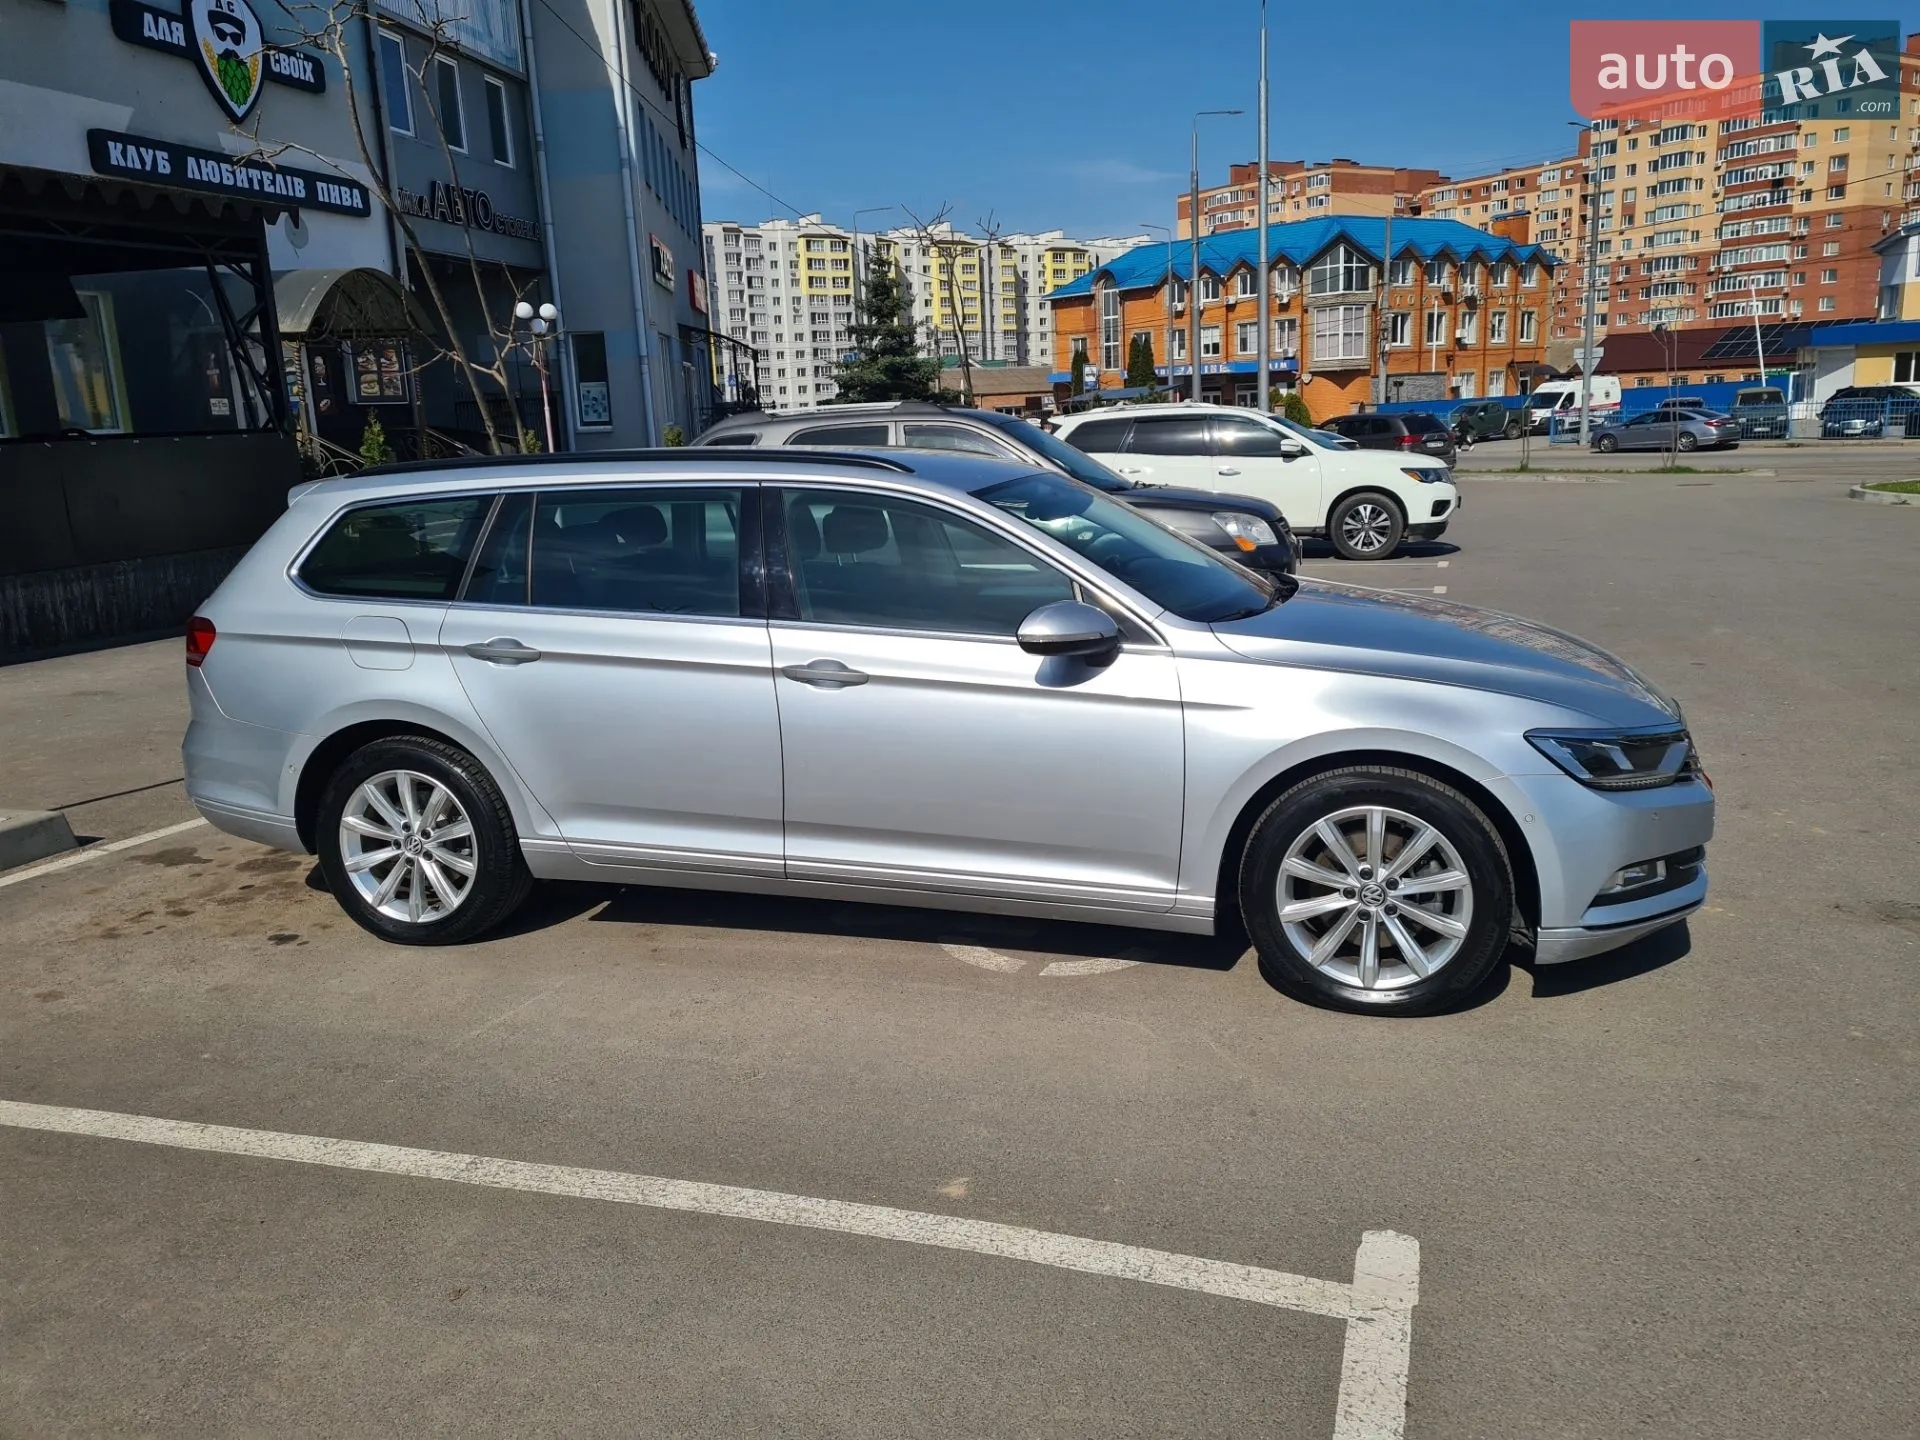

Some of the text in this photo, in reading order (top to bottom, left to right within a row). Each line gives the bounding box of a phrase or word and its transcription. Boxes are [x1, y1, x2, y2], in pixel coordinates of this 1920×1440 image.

[143, 12, 315, 83] ДЛЯ СВОЇХ
[107, 140, 364, 209] КЛУБ ЛЮБИТЕЛІВ ПИВА
